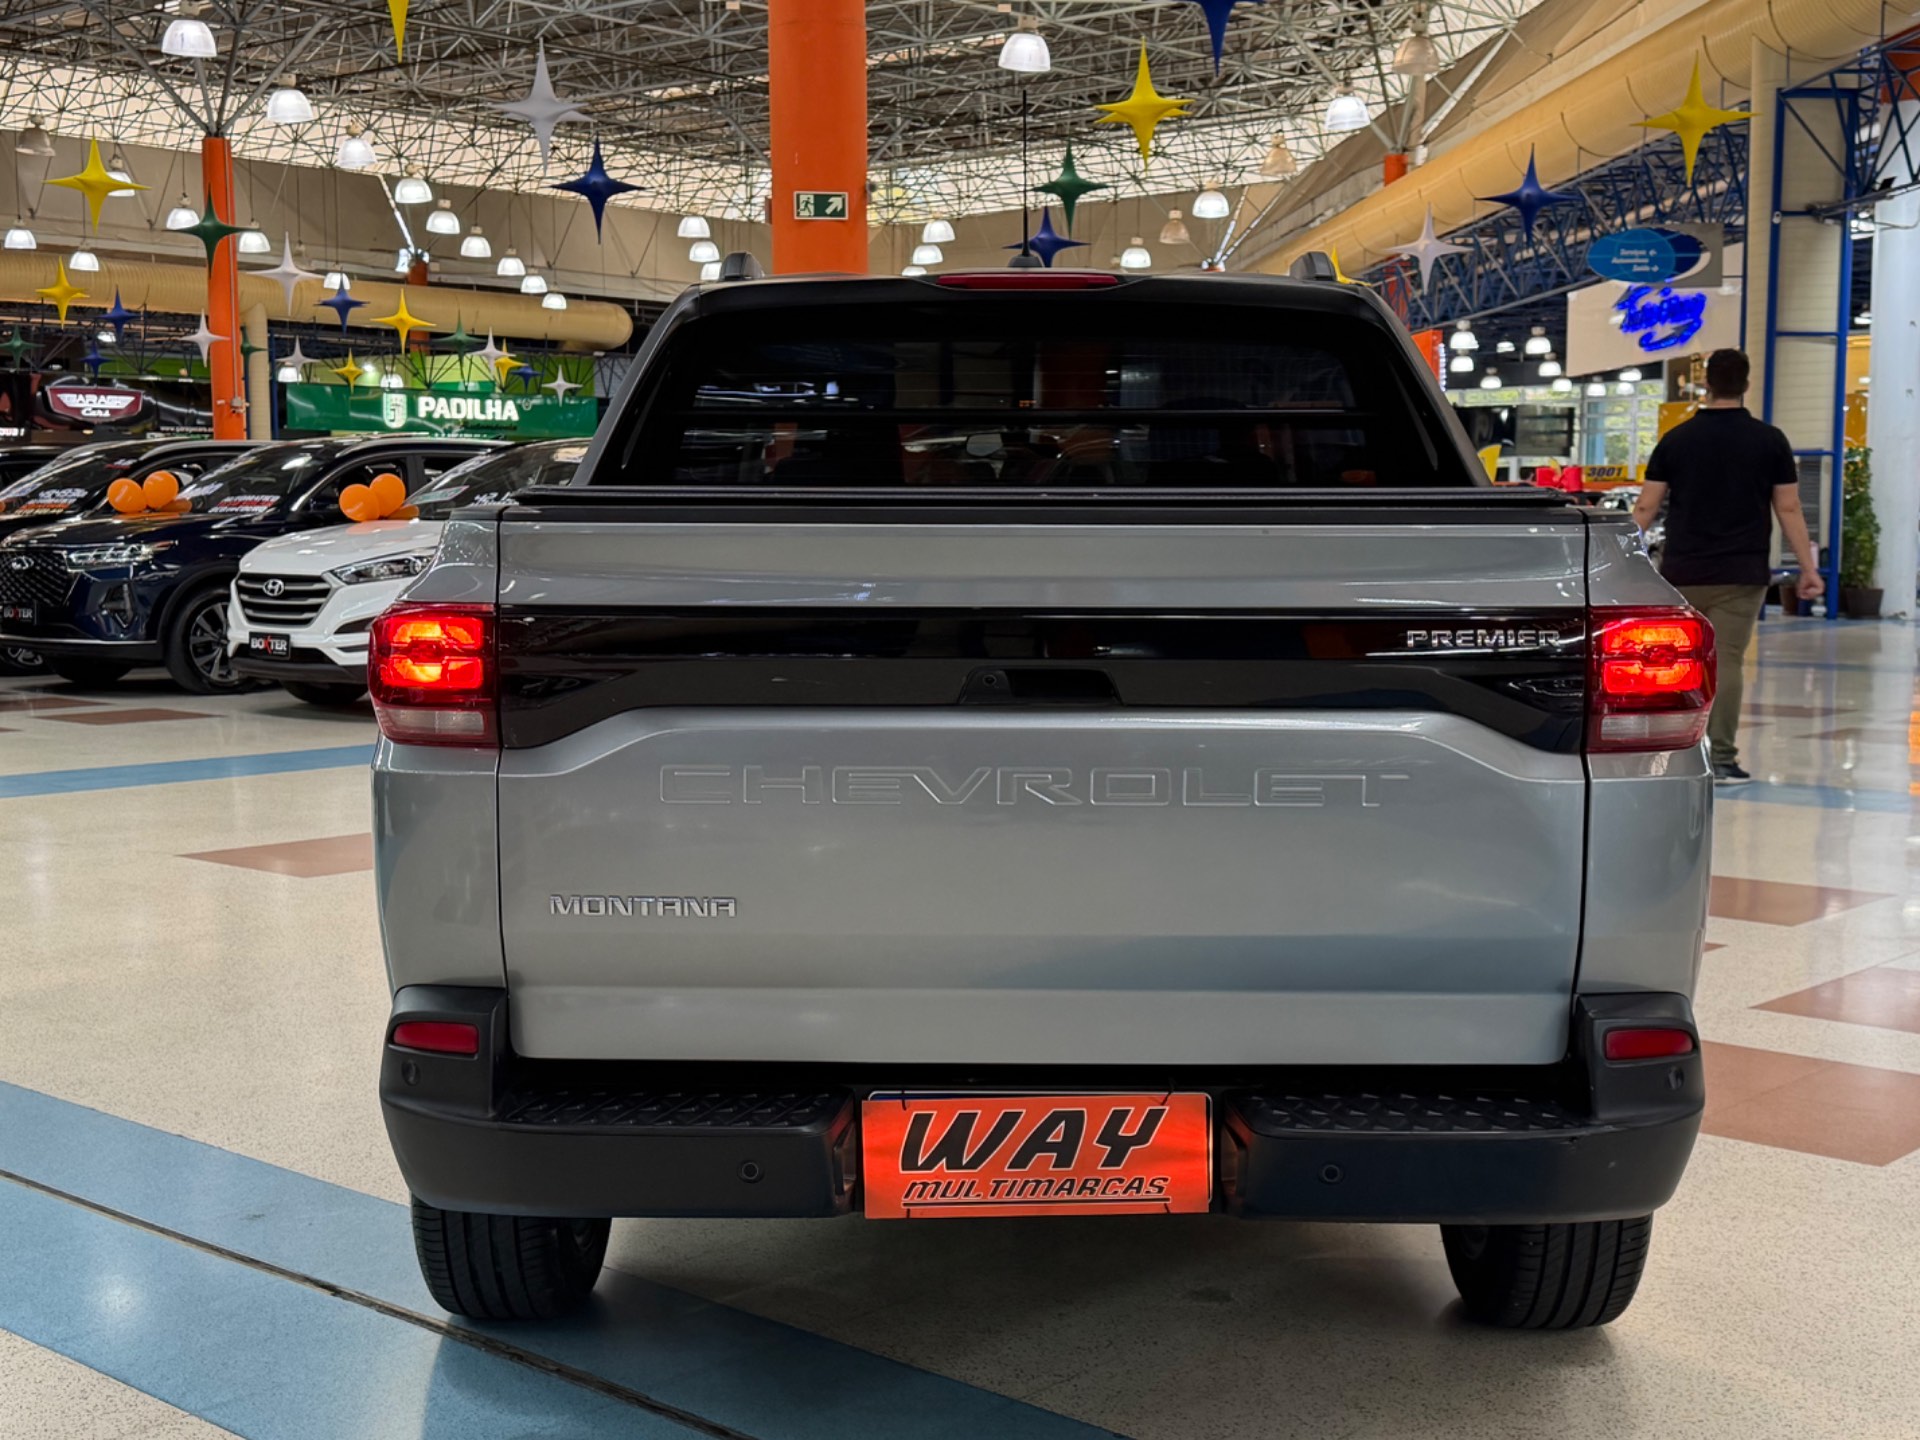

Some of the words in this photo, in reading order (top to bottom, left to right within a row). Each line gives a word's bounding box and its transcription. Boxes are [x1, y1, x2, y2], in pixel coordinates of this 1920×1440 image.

[417, 396, 519, 421] PADILHA
[1588, 467, 1623, 478] 3001
[1406, 629, 1561, 648] PREMIER
[659, 764, 1411, 808] CHEVROLET
[549, 894, 737, 918] MONTANA
[899, 1106, 1170, 1174] WAY
[903, 1176, 1172, 1200] MULTIMARCAS
